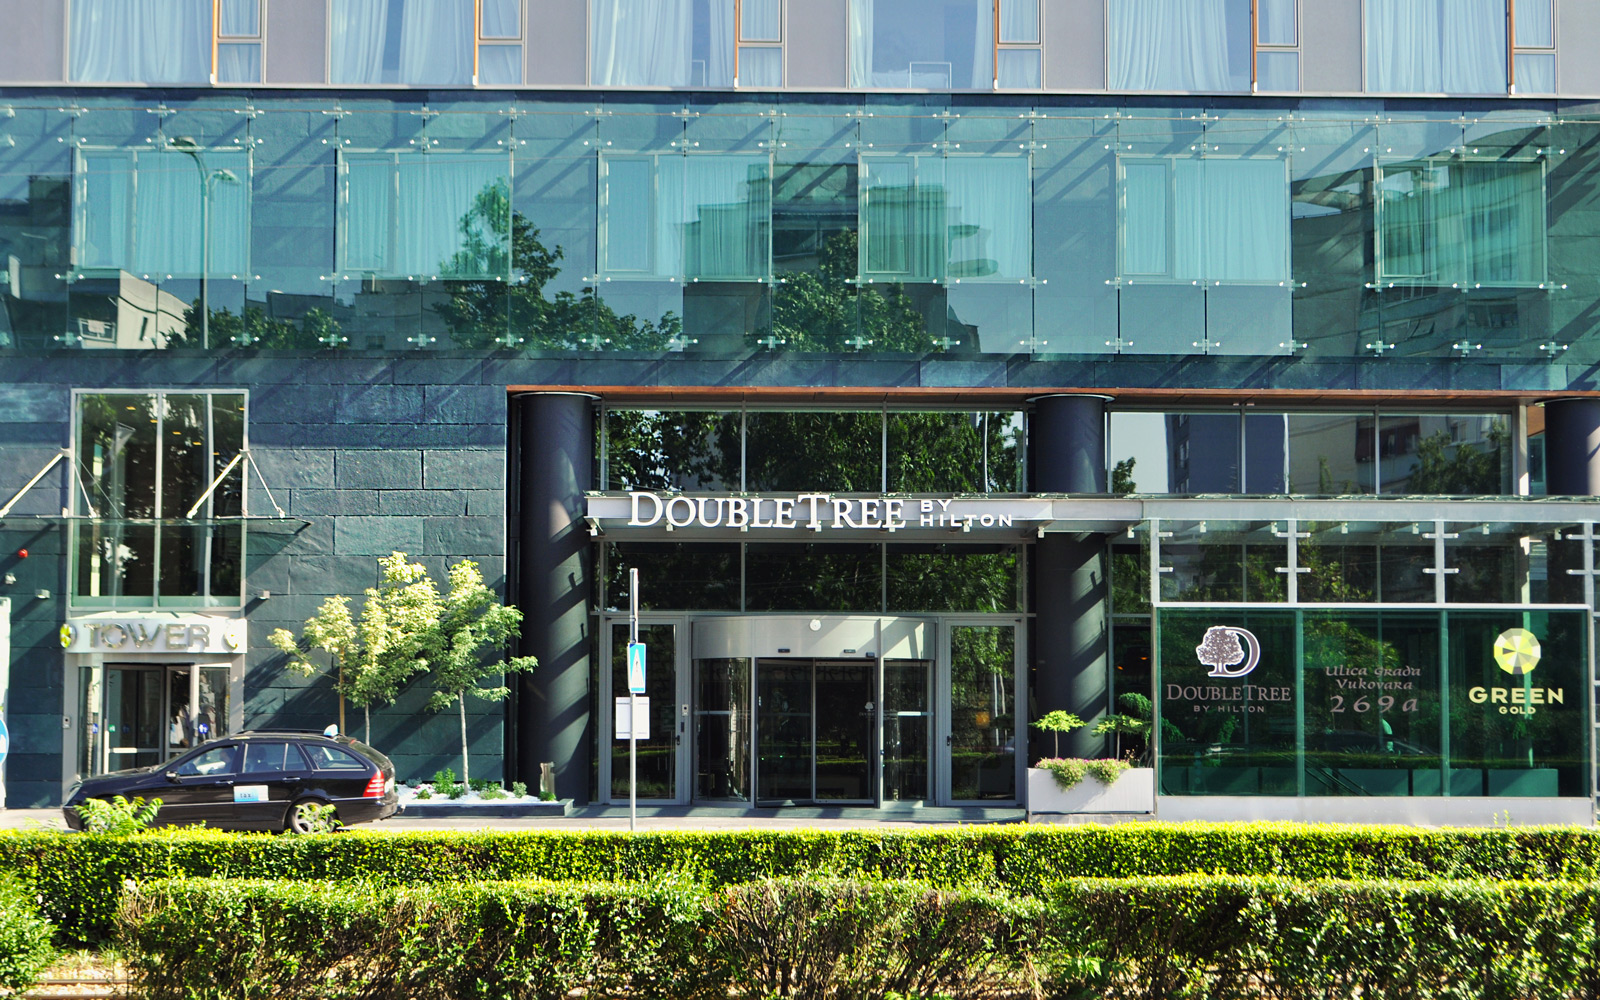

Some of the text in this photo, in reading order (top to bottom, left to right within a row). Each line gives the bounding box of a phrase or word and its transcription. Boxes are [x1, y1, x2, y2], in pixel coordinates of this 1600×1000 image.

[920, 500, 951, 512] BY
[920, 514, 1012, 527] HILTON
[84, 623, 210, 649] TOWER
[1325, 664, 1368, 677] Ulica
[1336, 678, 1412, 690] Vukovara
[1468, 686, 1564, 704] GREEN
[1193, 705, 1265, 713] BY HILTON
[1498, 706, 1536, 715] GOLD
